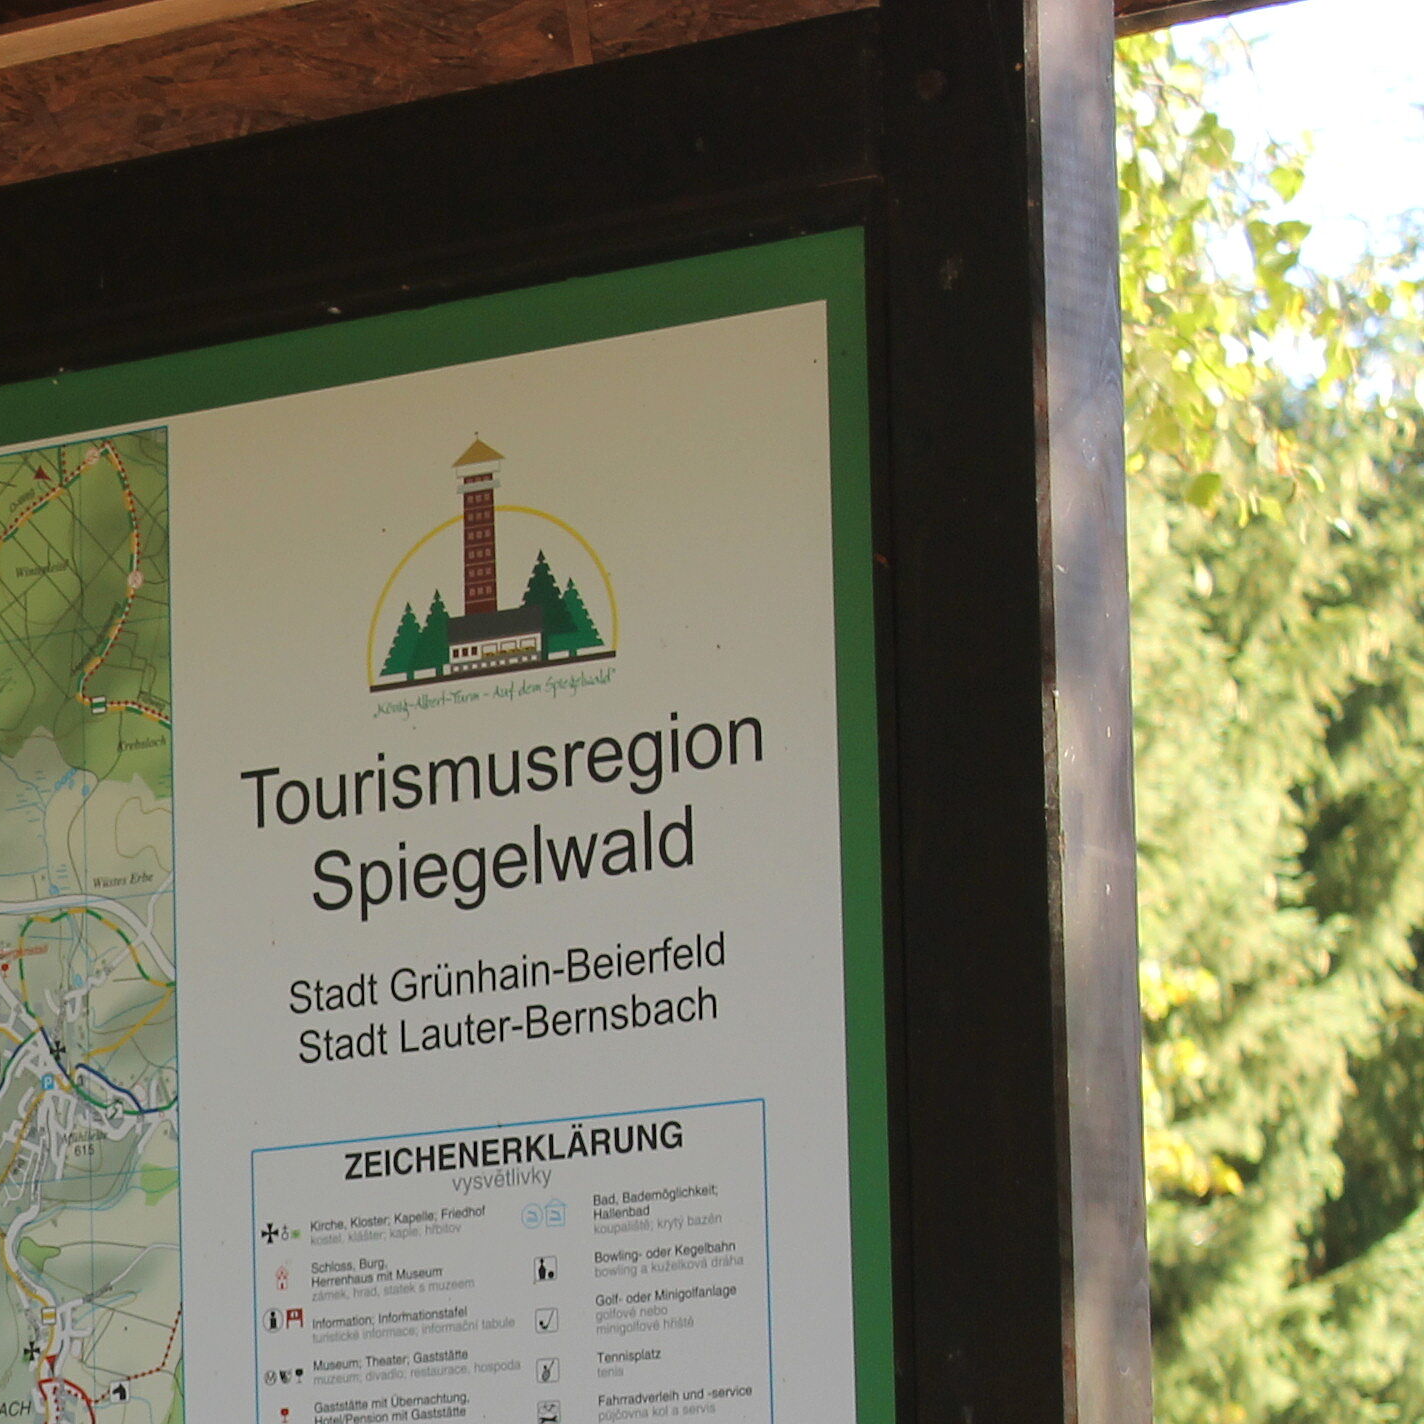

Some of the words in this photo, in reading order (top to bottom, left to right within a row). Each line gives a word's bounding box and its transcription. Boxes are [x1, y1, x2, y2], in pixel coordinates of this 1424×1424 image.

[241, 712, 764, 828] Tourismusregion
[312, 804, 695, 922] Spiegelwald
[289, 974, 378, 1014] Stadt
[390, 931, 726, 1002] Grünhain-Beierfeld
[298, 1021, 388, 1064] Stadt
[399, 987, 718, 1054] Lauter-Bernsbach
[345, 1120, 684, 1181] ZEICHENERKLÄRUNG
[452, 1167, 552, 1193] vysvětlivky
[442, 1205, 485, 1219] Friedhof
[646, 1247, 671, 1259] oder
[675, 1242, 735, 1258] Kegelbahn
[312, 1275, 373, 1287] Herrenhaus
[377, 1272, 392, 1281] mit
[397, 1268, 442, 1279] Museum
[626, 1292, 651, 1303] oder
[655, 1285, 736, 1302] Minigolfanlage
[597, 1349, 661, 1363] Tennisplatz
[599, 1391, 679, 1406] Fahrradverleih
[683, 1388, 704, 1400] und
[392, 1411, 407, 1420] mit
[412, 1407, 466, 1420] Gaststätte
